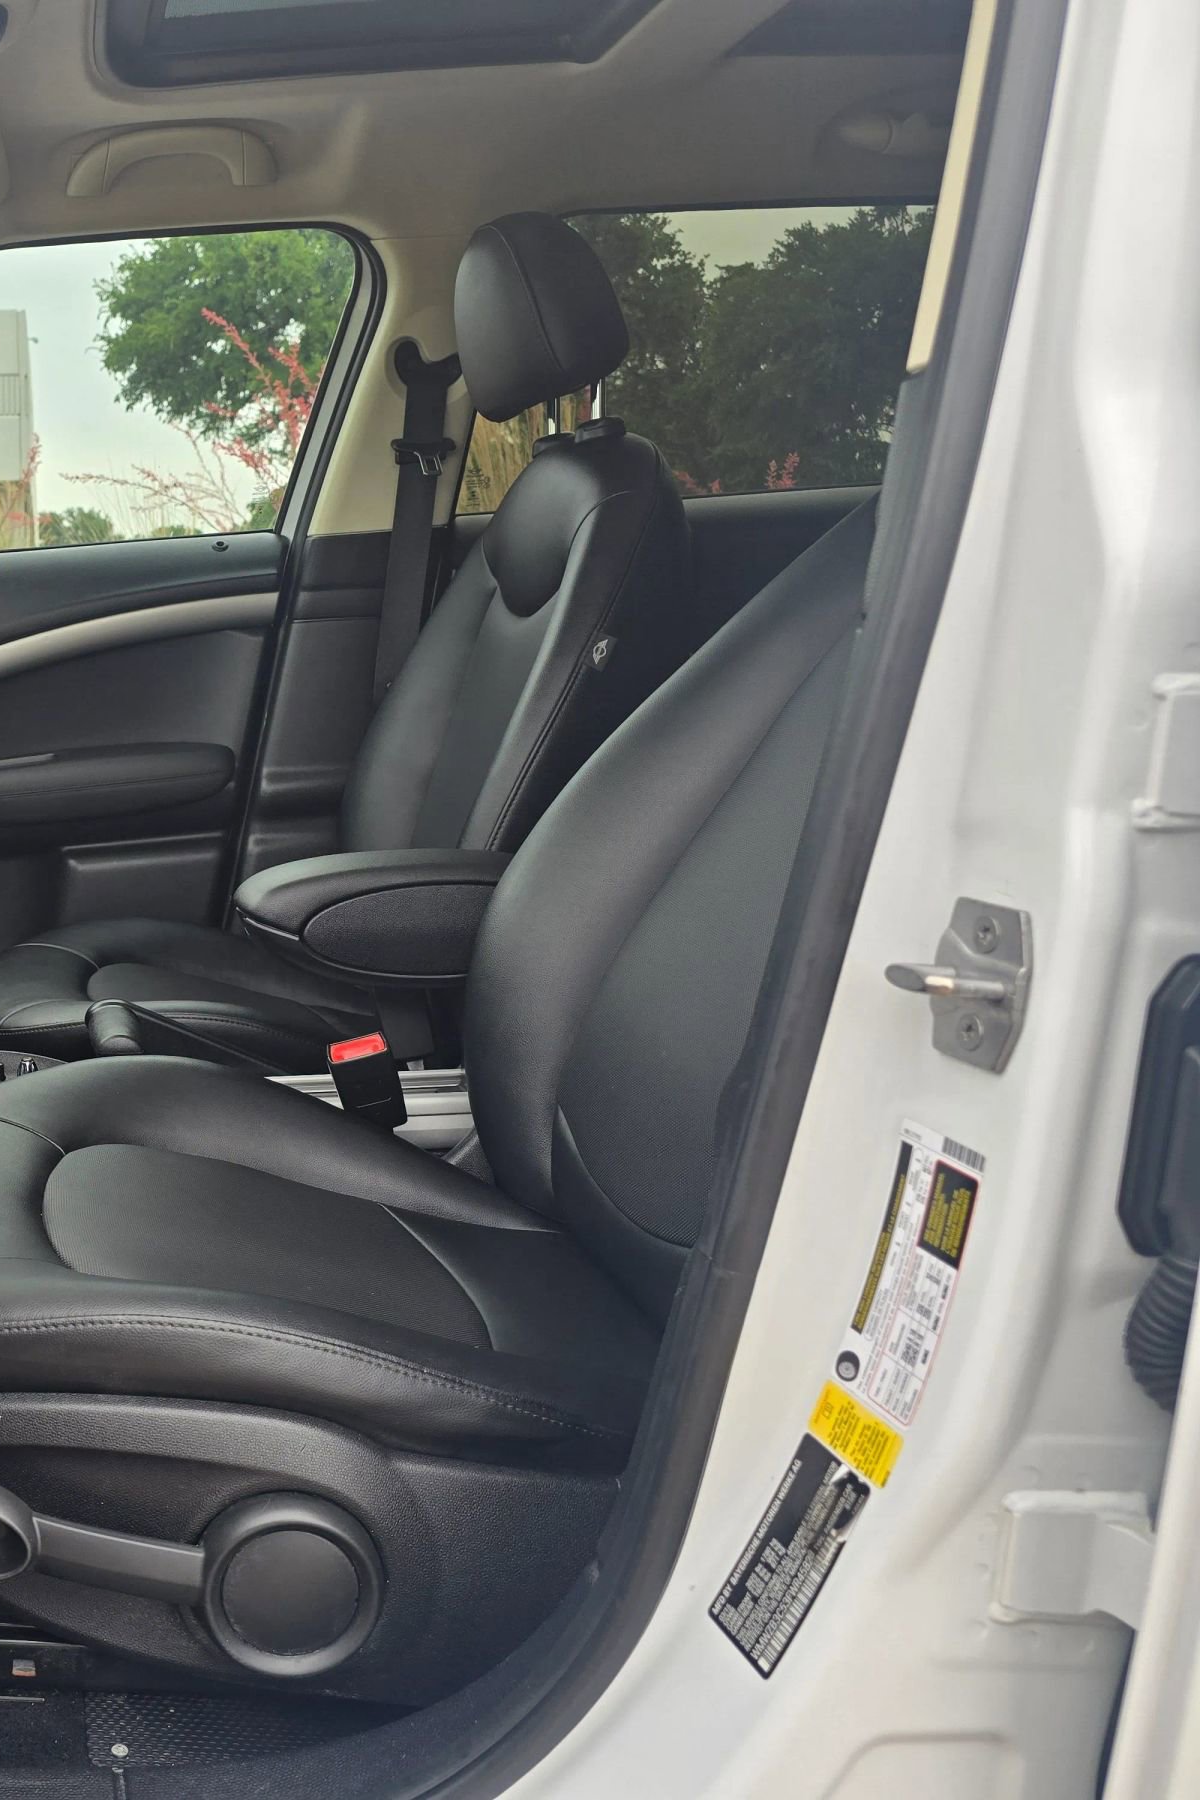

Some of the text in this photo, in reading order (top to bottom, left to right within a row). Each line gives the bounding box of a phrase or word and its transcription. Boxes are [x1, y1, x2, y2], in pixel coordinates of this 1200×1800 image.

[711, 1595, 725, 1615] MFD
[721, 1582, 732, 1597] BY
[729, 1536, 760, 1585] BAYERISCHE
[756, 1497, 781, 1538] MOTOREN
[777, 1470, 795, 1499] WERKE
[791, 1458, 802, 1473] AG
